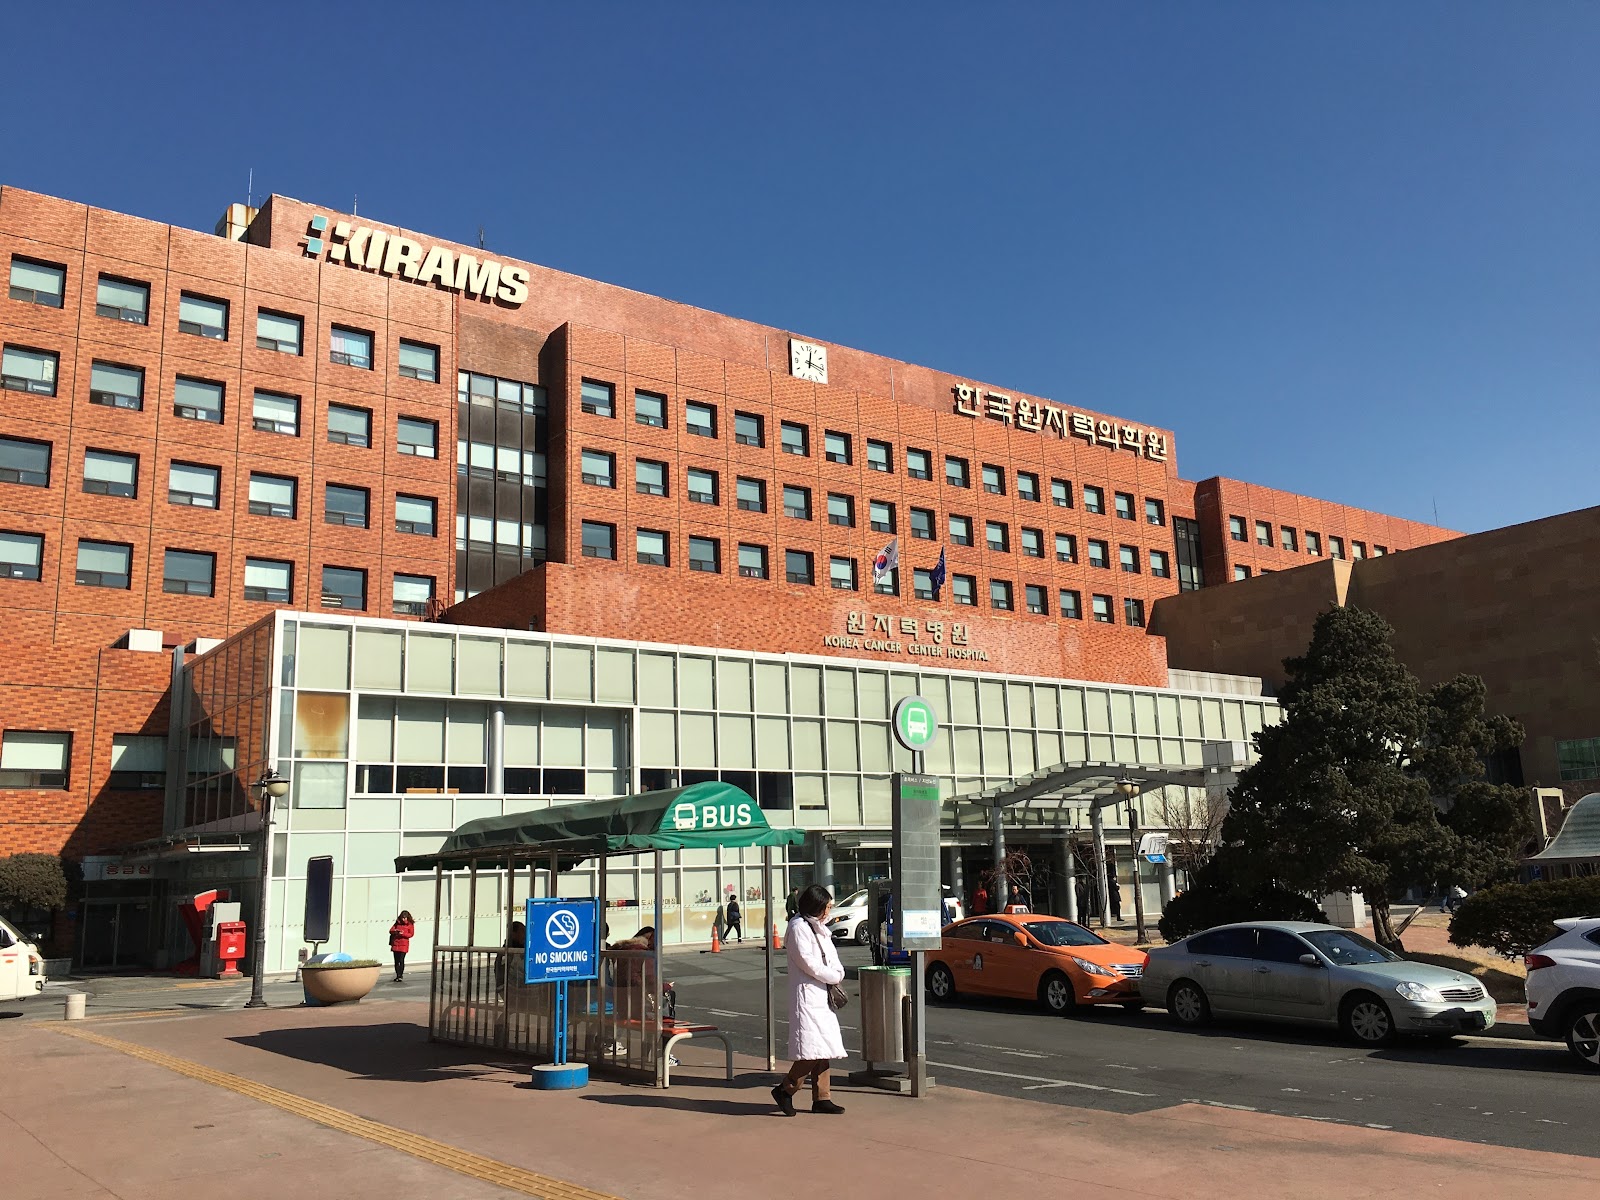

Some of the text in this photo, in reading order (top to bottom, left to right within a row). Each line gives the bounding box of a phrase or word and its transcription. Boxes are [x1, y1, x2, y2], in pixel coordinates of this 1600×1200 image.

[330, 221, 530, 304] KIRAMS
[954, 382, 1168, 461] 한국원자력의학원
[848, 610, 969, 645] 원자력병원
[824, 635, 989, 662] KOREA CANCER CENTER HOSPITAL
[702, 803, 752, 828] BUS
[106, 864, 151, 875] 응급실
[535, 950, 588, 964] NO SMOKING
